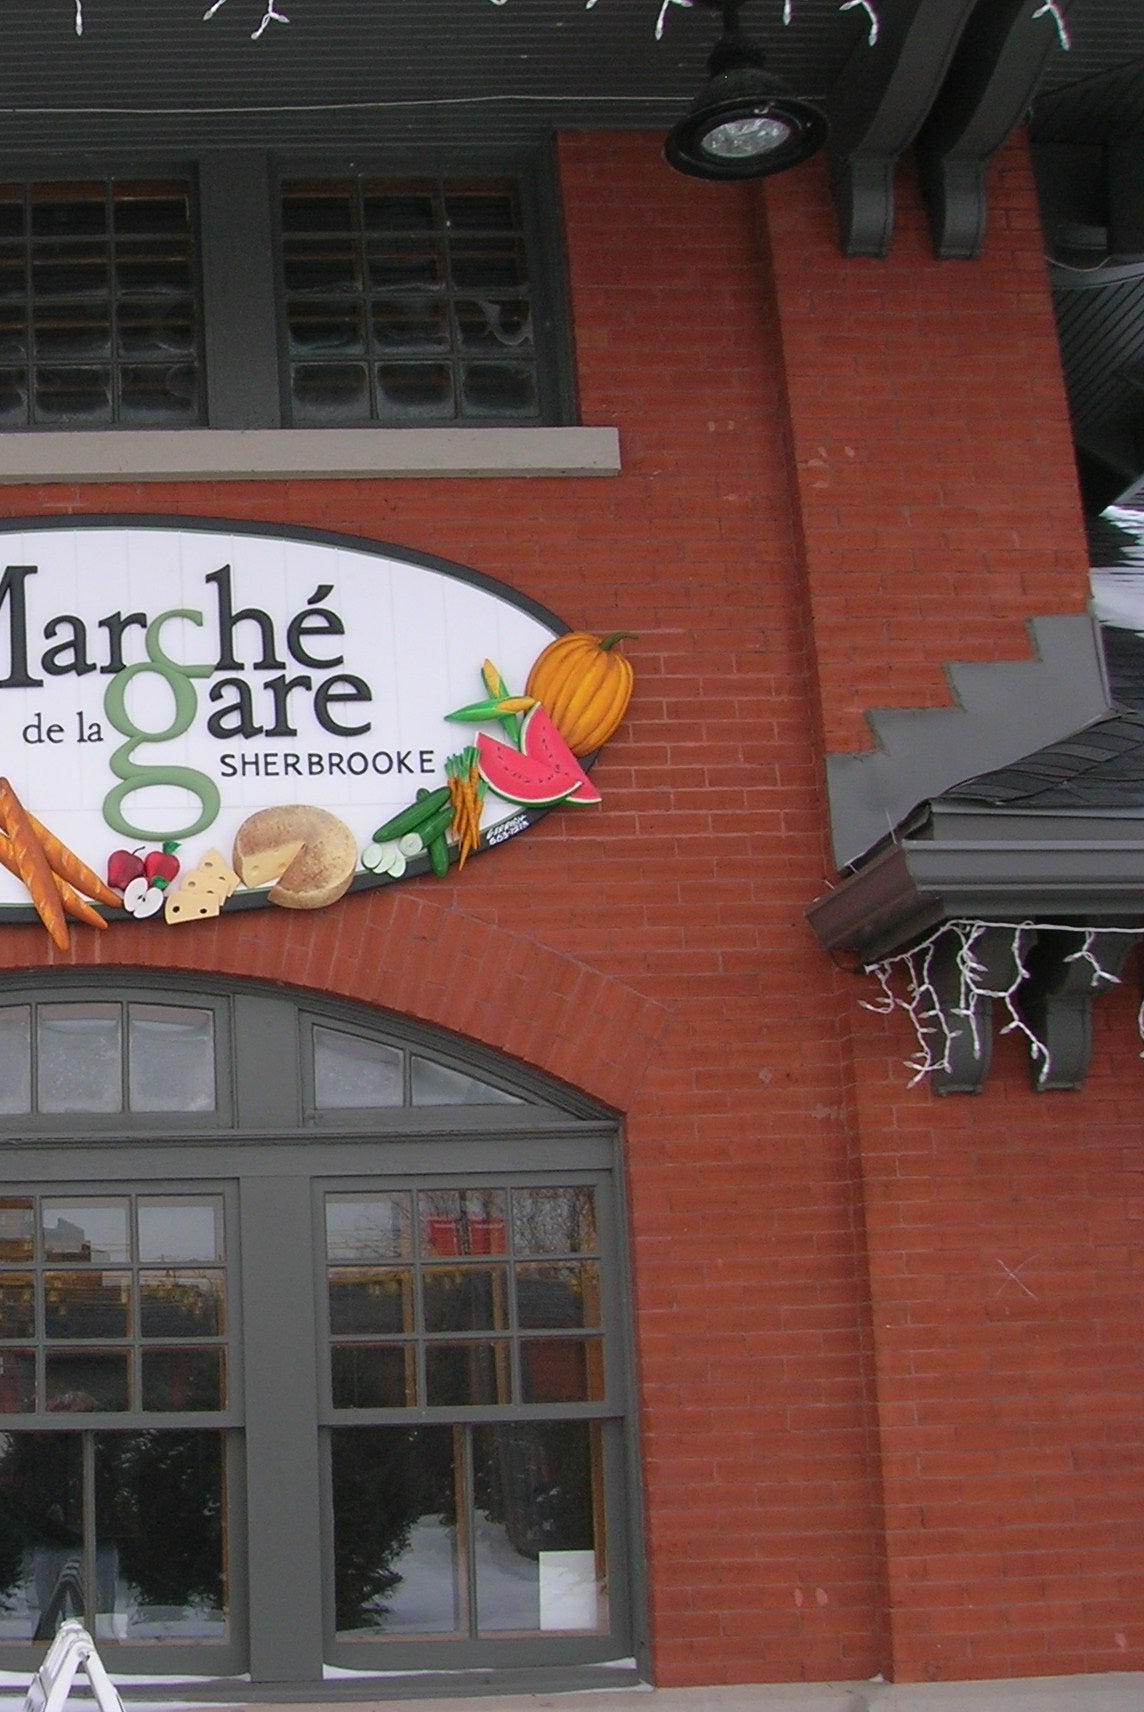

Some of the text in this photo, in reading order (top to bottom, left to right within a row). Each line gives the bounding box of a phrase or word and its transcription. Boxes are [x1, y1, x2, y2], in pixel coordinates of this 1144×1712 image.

[22, 661, 373, 842] de la gare
[219, 750, 436, 778] SHERBROOKE
